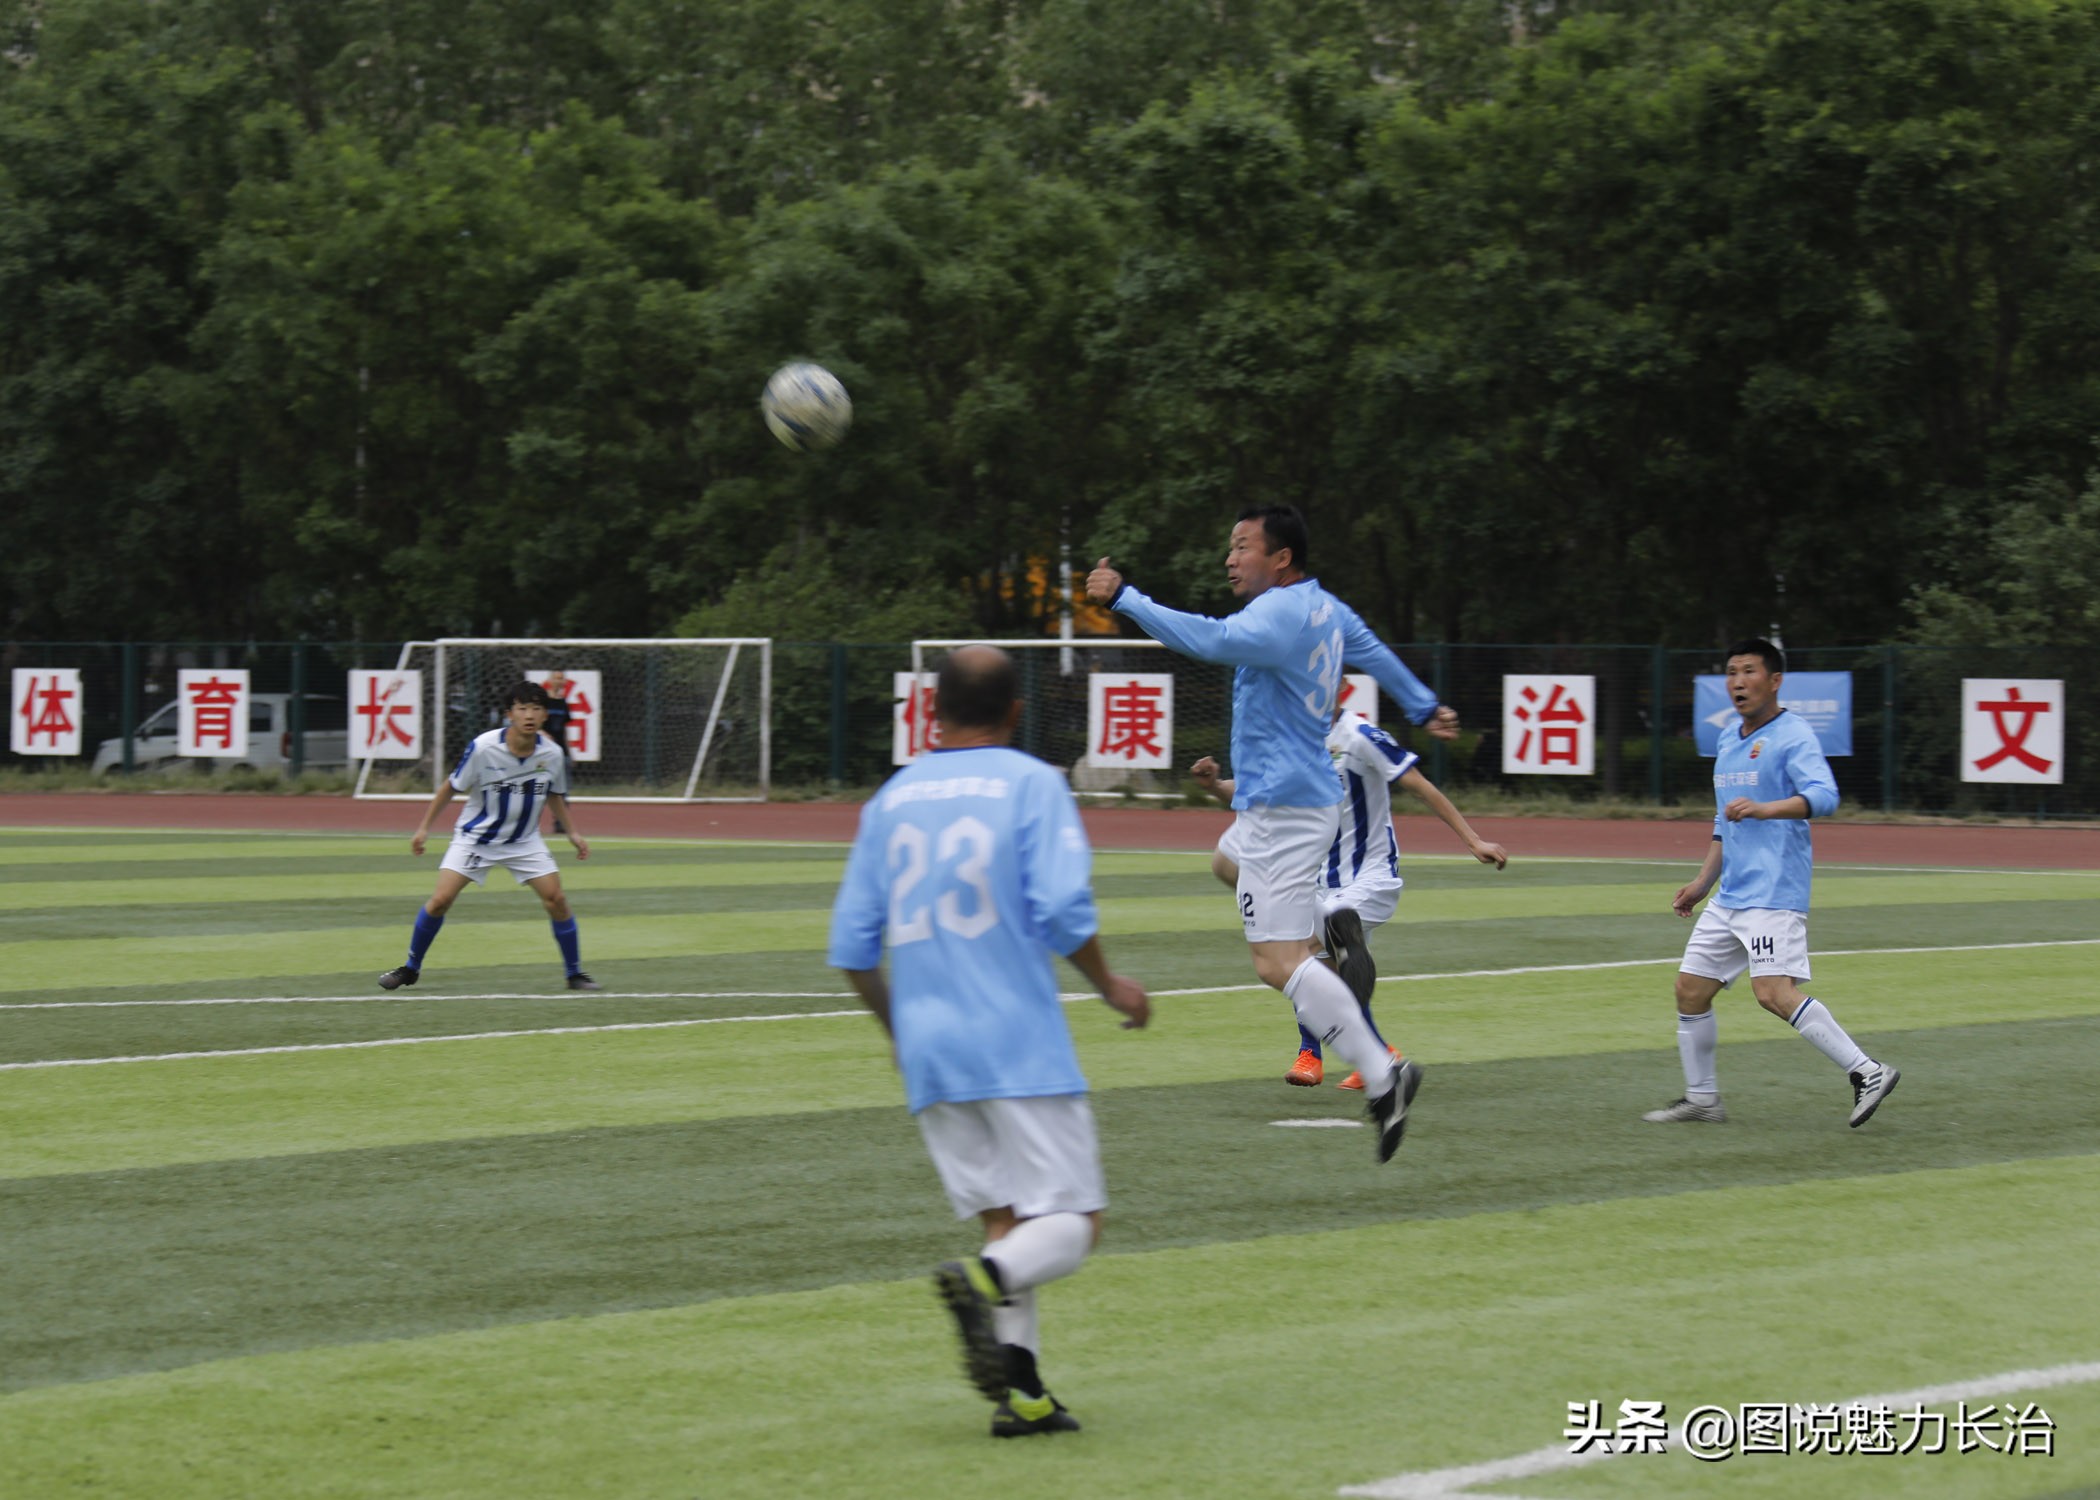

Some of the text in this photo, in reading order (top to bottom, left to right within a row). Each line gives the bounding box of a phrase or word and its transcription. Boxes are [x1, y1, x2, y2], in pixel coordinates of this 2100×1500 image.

[20, 676, 74, 747] 体
[187, 676, 241, 749] 育
[356, 676, 413, 747] 长
[1098, 681, 1165, 760] 康
[1514, 684, 1586, 766] 治
[1974, 687, 2053, 774] 文
[886, 816, 1000, 947] 23
[1751, 935, 1774, 956] 44
